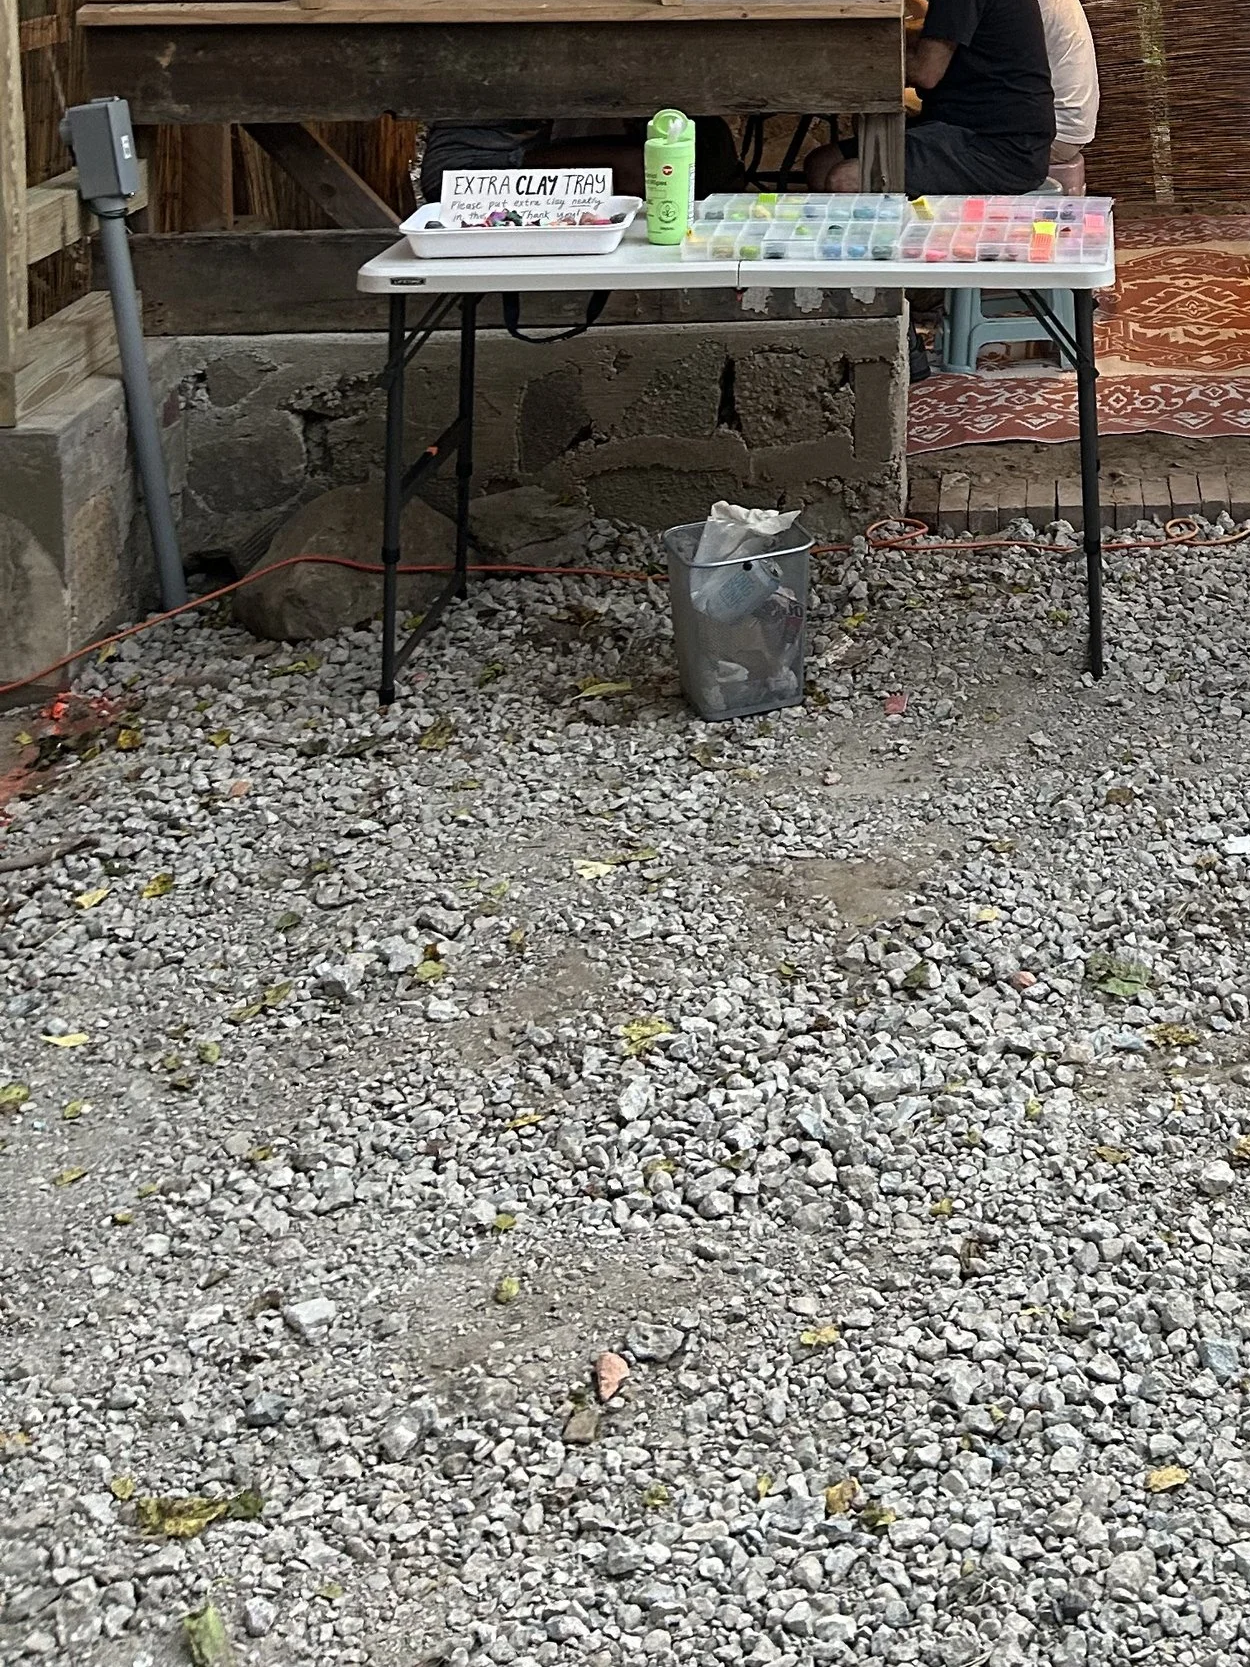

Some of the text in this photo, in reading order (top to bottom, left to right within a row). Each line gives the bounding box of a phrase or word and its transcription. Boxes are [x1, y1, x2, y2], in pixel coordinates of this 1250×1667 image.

[454, 173, 606, 196] EXTRA CLAY TRAY
[451, 201, 482, 210] Please
[488, 199, 508, 210] put
[513, 199, 541, 207] extra
[521, 210, 551, 220] Thank
